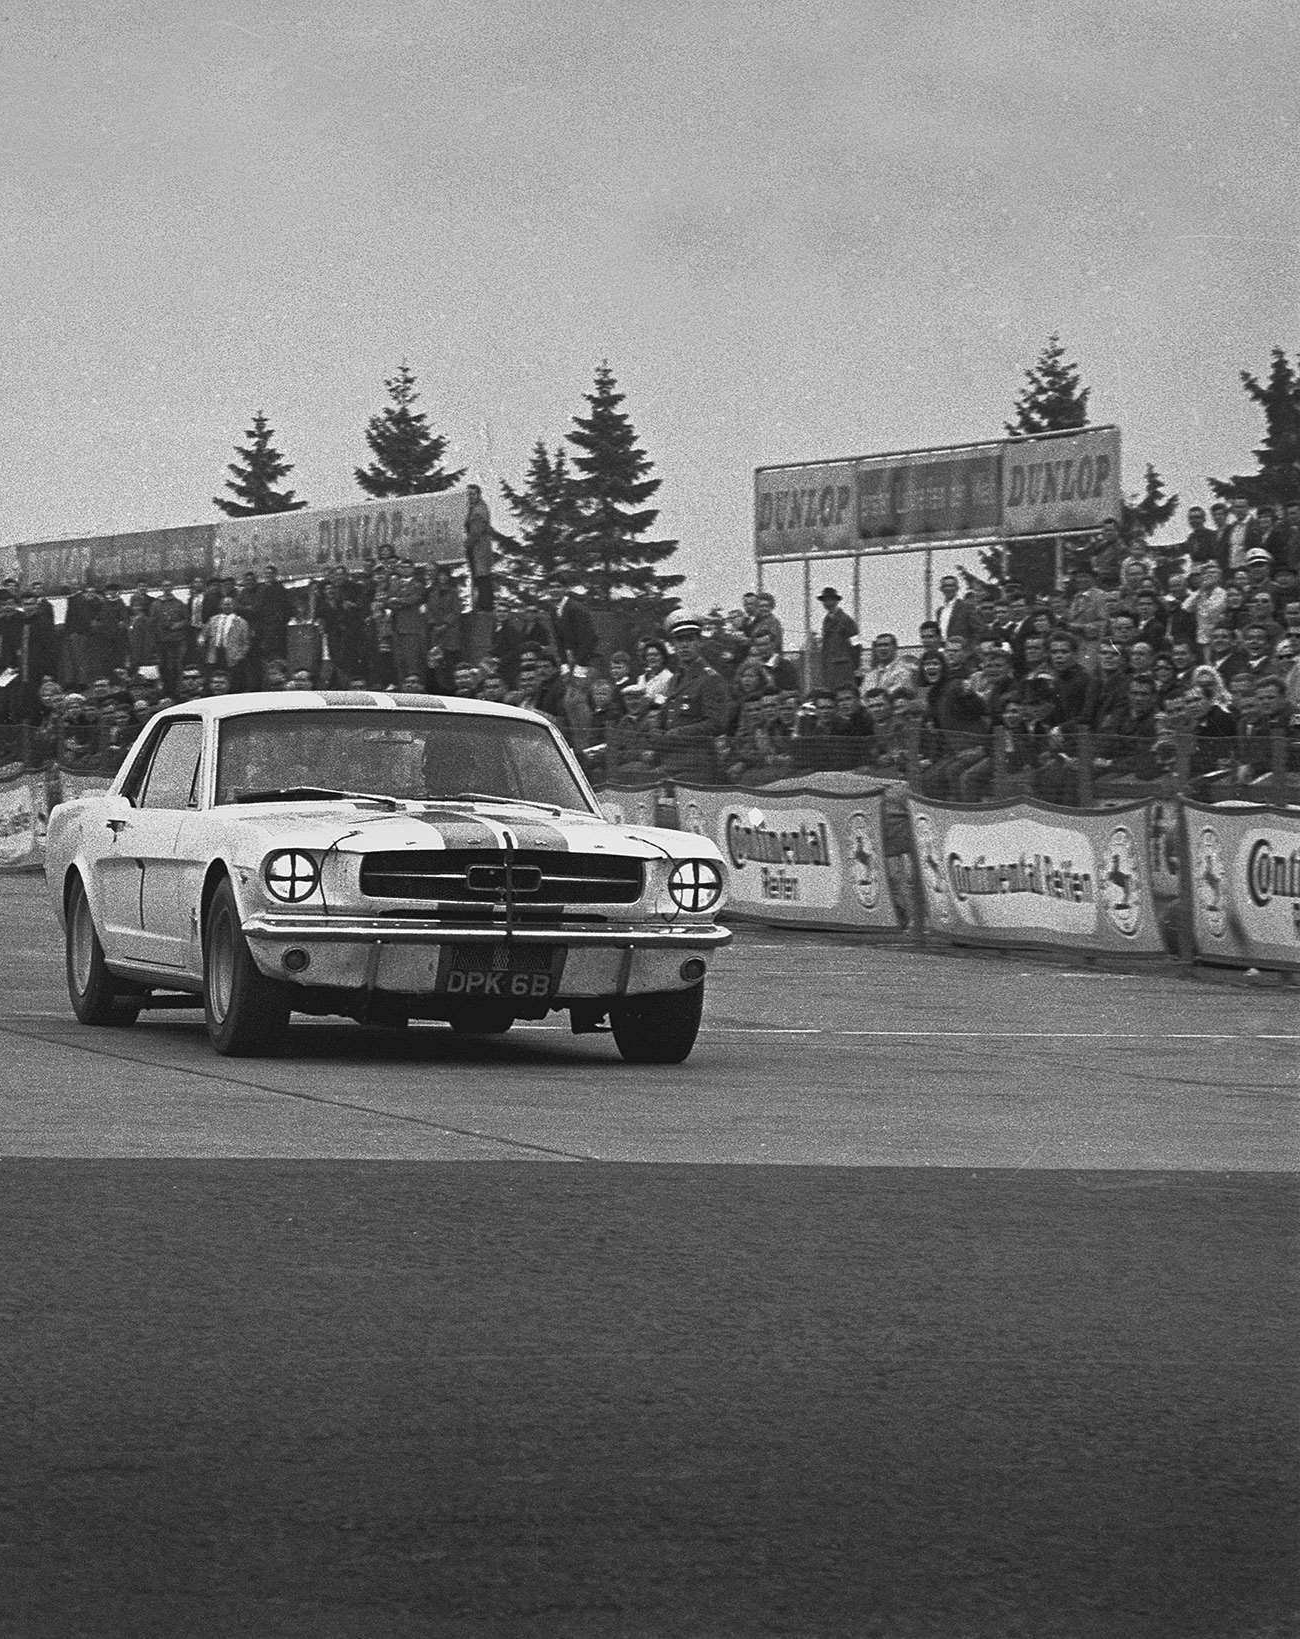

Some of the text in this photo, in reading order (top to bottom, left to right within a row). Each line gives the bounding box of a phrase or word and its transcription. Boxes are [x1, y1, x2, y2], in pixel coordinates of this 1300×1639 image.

[1008, 453, 1110, 507] DUNLOP
[757, 485, 850, 531] DUNLOP
[447, 971, 550, 996] DPK 6B
